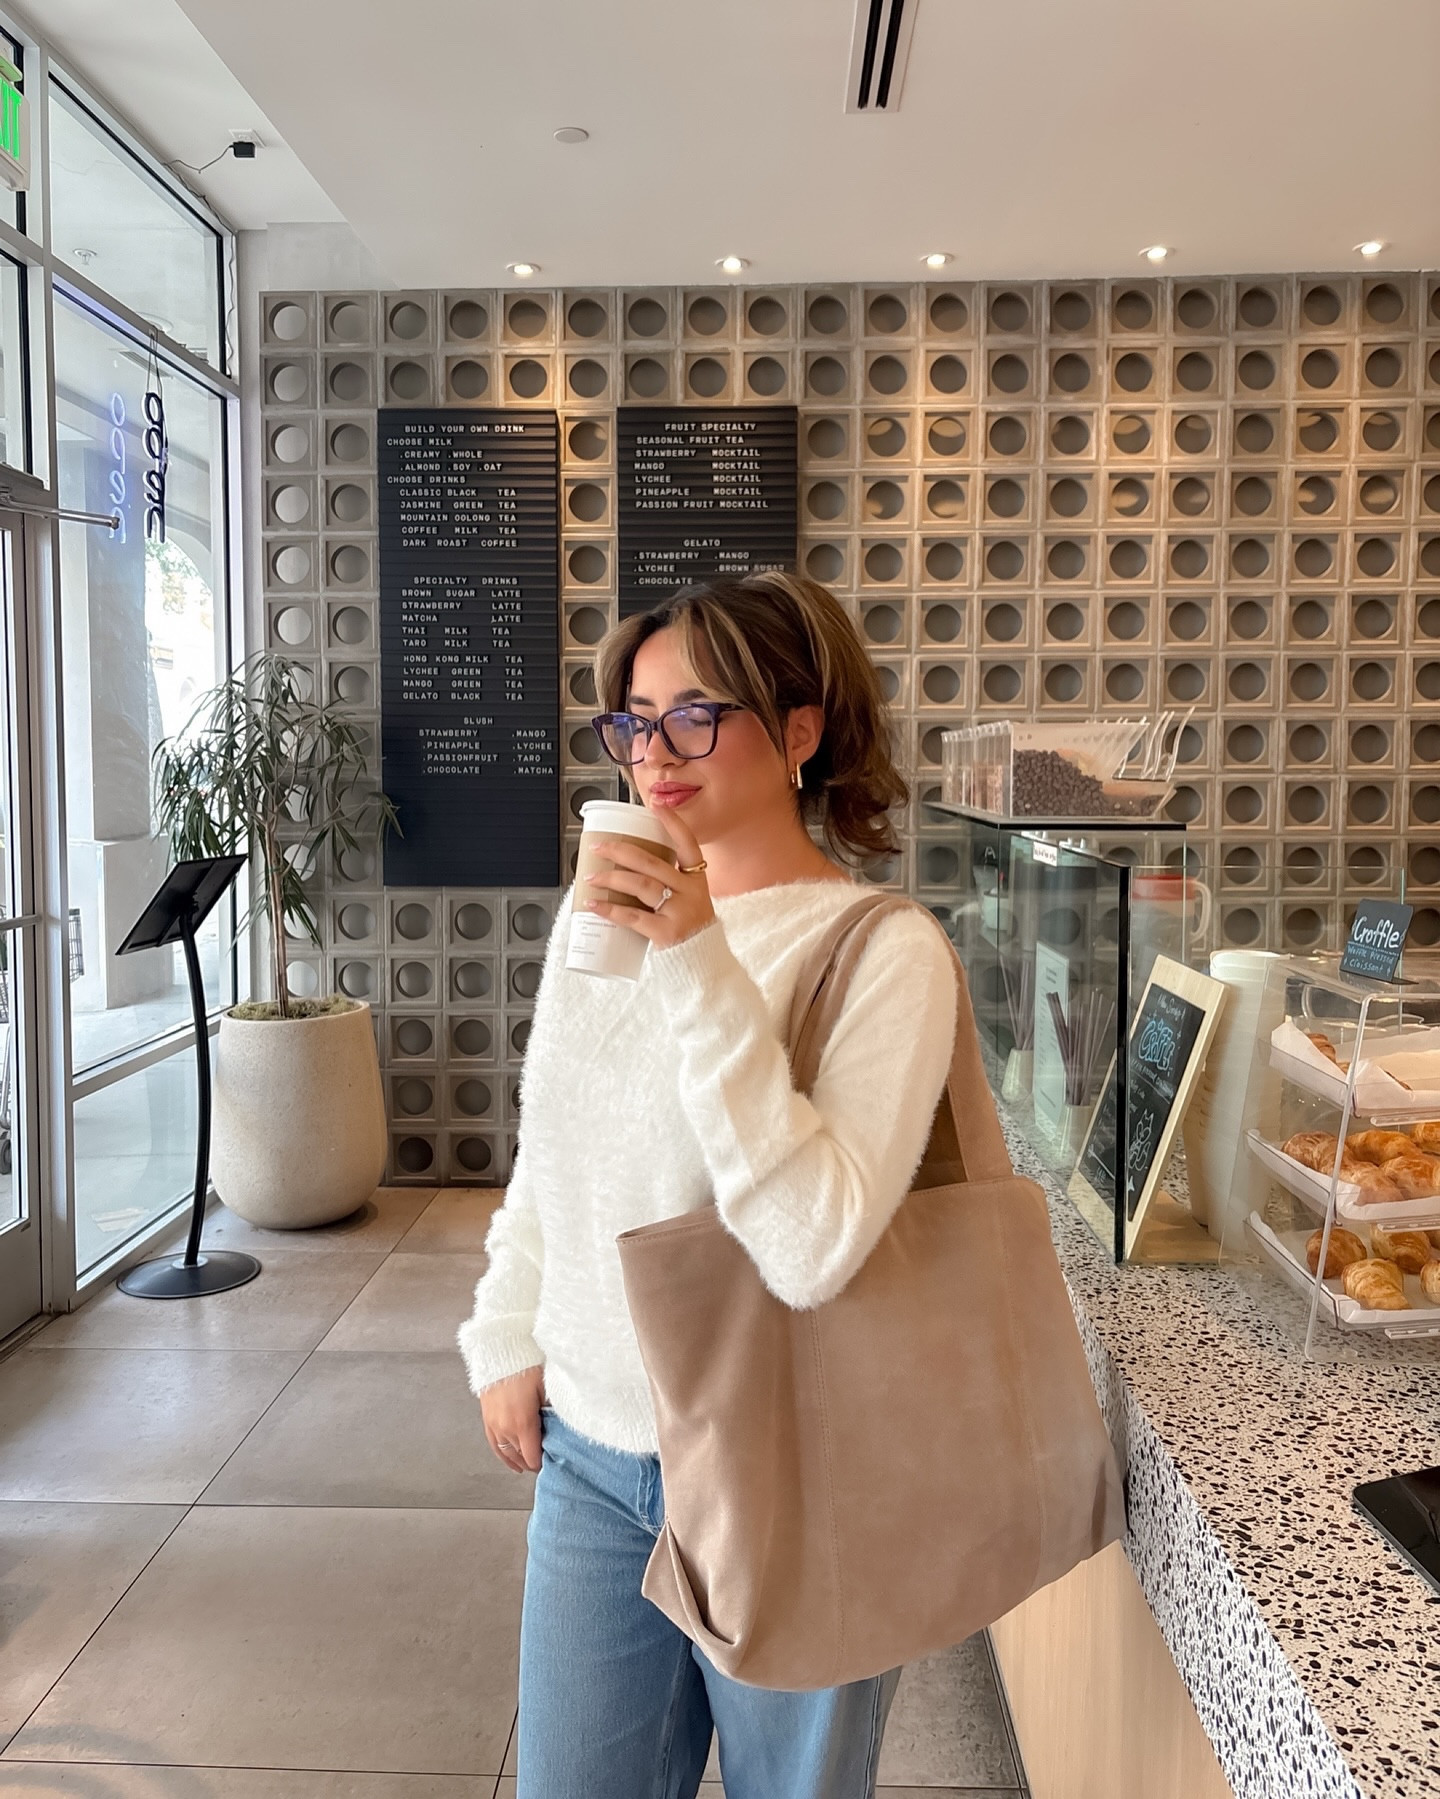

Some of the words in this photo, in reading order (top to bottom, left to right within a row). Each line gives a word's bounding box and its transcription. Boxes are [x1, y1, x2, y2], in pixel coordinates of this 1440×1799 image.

[0, 77, 22, 160] IT
[404, 425, 435, 433] BUILD
[440, 425, 465, 433] YOUR
[470, 425, 488, 433] OWN
[494, 425, 525, 433] DRINK
[664, 423, 697, 431] FRUIT
[701, 423, 756, 431] SPECIALTY
[386, 438, 423, 446] CHOOSE
[428, 438, 452, 446] MILK
[636, 436, 685, 444] SEASONAL
[689, 436, 720, 444] FRUIT
[725, 436, 745, 444] TEA
[635, 449, 697, 457] STRAWBERRY
[711, 449, 761, 457] MOCKTAIL
[634, 462, 665, 470] MANGO
[711, 462, 761, 470] MOCKTAIL
[386, 476, 423, 484] CHOOSE
[429, 476, 466, 484] DRINKS
[635, 475, 671, 483] LYCHEE
[712, 475, 761, 483] MOCKTAIL
[399, 489, 442, 497] CLASSIC
[447, 489, 477, 497] BLACK
[498, 489, 517, 497] TEA
[635, 488, 690, 496] PINEAPPLE
[713, 488, 762, 496] MOCKTAIL
[400, 501, 441, 509] JASMINE
[453, 501, 484, 509] GREEN
[498, 501, 517, 509] TEA
[635, 501, 678, 509] PASSION
[683, 501, 714, 509] FRUIT
[719, 501, 769, 509] MOCKTAIL
[400, 514, 448, 522] MOUNTAIN
[454, 514, 491, 522] OOLONG
[498, 514, 517, 522] TEA
[401, 526, 438, 535] COFFEE
[454, 526, 479, 535] MILK
[498, 526, 517, 535] TEA
[402, 539, 427, 547] DARK
[436, 539, 468, 547] ROAST
[480, 539, 518, 547] COFFEE
[683, 539, 721, 547] GELATO
[413, 577, 468, 585] SPECIALTY
[481, 577, 518, 585] DRINKS
[401, 589, 432, 598] BROWN
[446, 589, 476, 598] SUGAR
[491, 589, 521, 598] LATTE
[401, 602, 462, 610] STRAWBERRY
[491, 602, 522, 610] LATTE
[401, 614, 438, 623] MATCHA
[491, 614, 521, 623] LATTE
[401, 627, 426, 635] THAI
[444, 627, 469, 635] MILK
[492, 627, 510, 635] TEA
[402, 639, 427, 648] TARO
[444, 639, 469, 648] MILK
[492, 639, 511, 648] TEA
[403, 655, 428, 664] HONG
[435, 655, 460, 664] KONG
[465, 655, 489, 664] MILK
[504, 655, 523, 664] TEA
[403, 667, 439, 676] LYCHEE
[451, 667, 482, 676] GREEN
[505, 667, 523, 676] TEA
[403, 680, 433, 688] MANGO
[451, 680, 482, 688] GREEN
[505, 680, 523, 688] TEA
[403, 692, 439, 701] GELATO
[450, 692, 481, 701] BLACK
[505, 692, 523, 701] TEA
[463, 717, 493, 725] SLUSH
[418, 729, 478, 738] STRAWBERRY
[1353, 916, 1400, 949] Croffle
